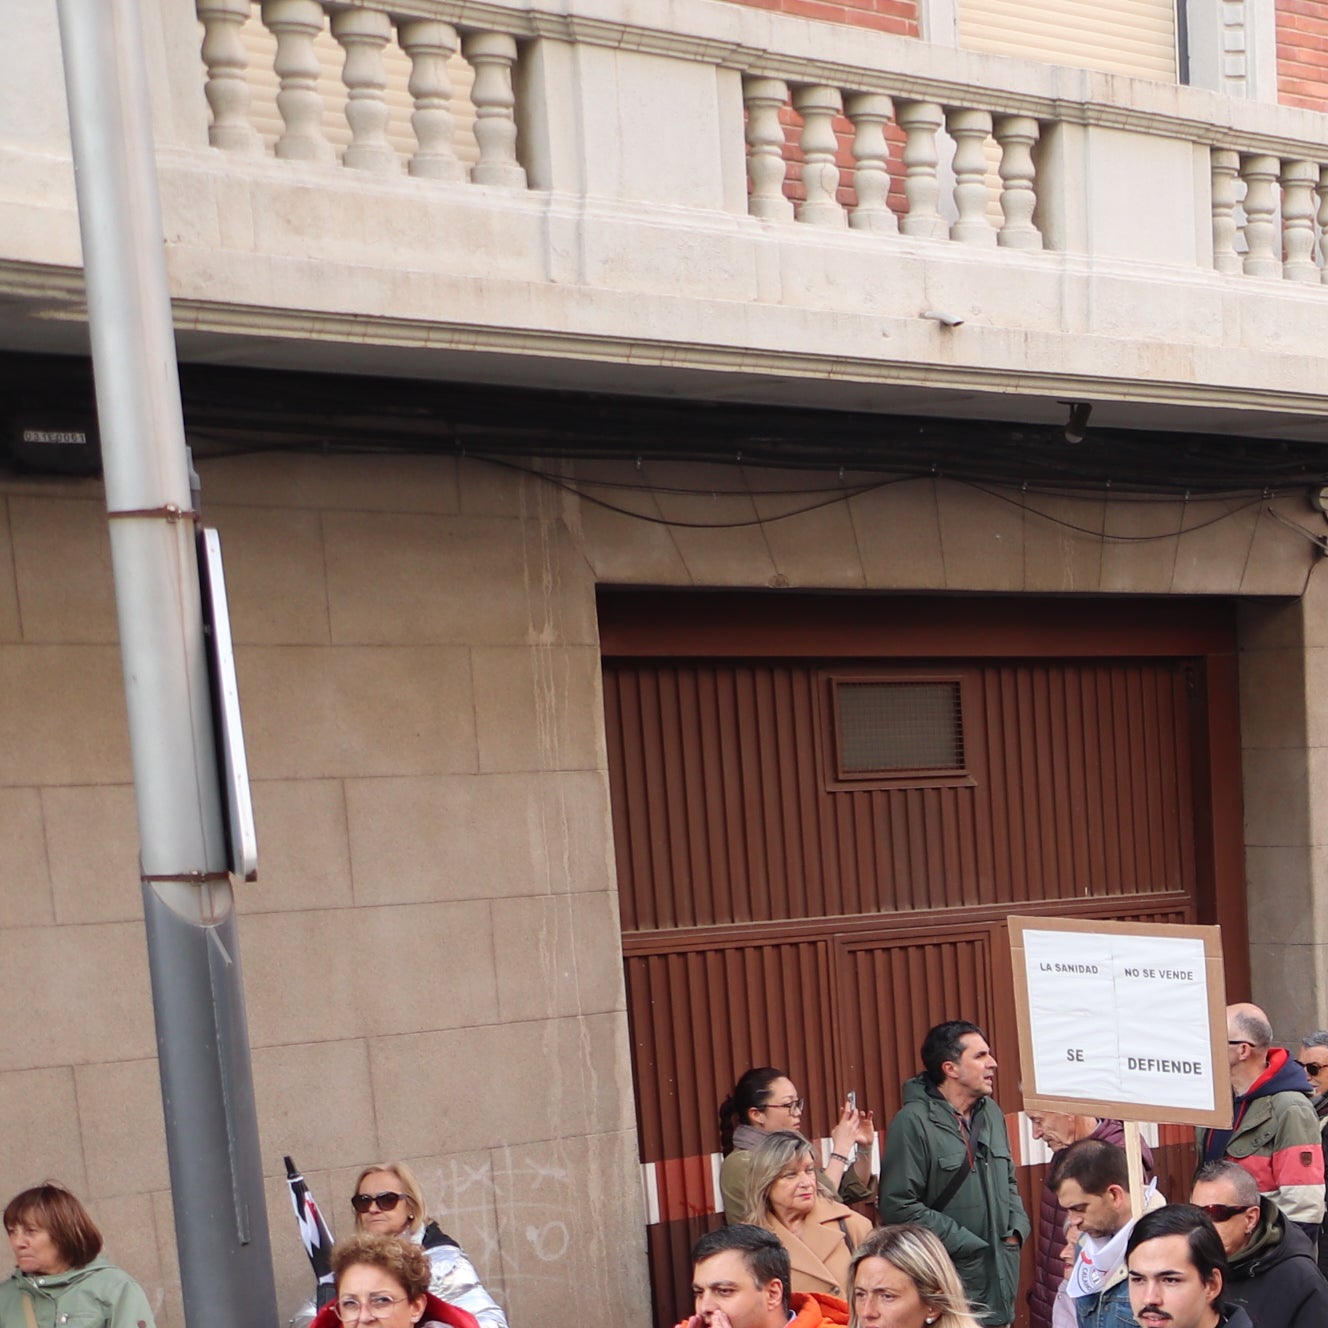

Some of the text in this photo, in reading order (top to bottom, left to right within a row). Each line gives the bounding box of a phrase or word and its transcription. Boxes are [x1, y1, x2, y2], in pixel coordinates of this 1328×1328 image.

[1039, 962, 1099, 975] LA SANIDAD
[1124, 967, 1194, 981] NO SE VENDE
[1066, 1048, 1084, 1063] SE
[1127, 1057, 1203, 1076] DEFIENDE
